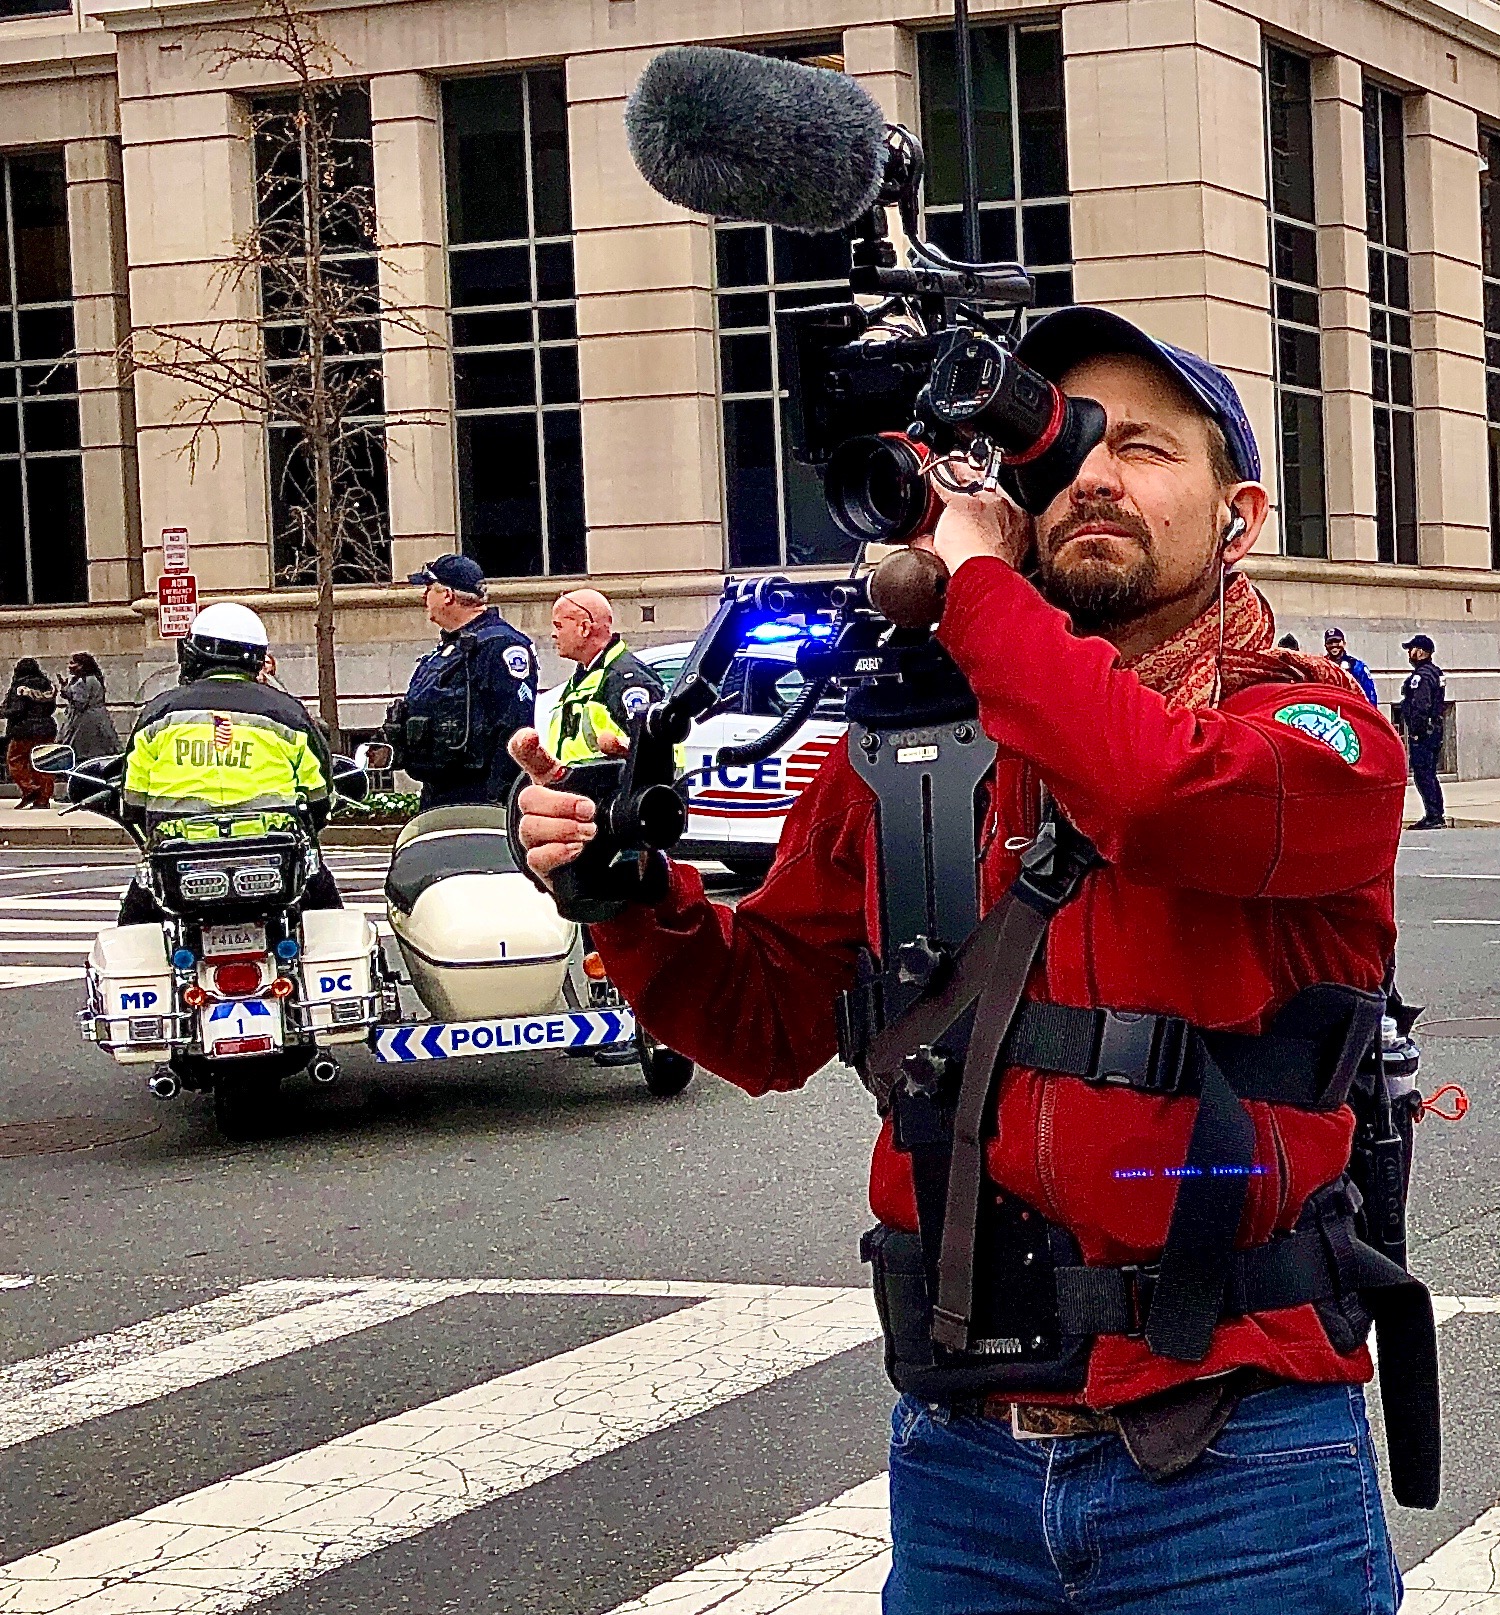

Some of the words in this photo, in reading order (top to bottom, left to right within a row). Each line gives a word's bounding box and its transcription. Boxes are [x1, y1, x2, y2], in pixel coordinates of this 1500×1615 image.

[854, 657, 880, 672] ARRI
[687, 754, 782, 790] ICE
[499, 941, 507, 957] 1
[319, 974, 353, 993] DC
[120, 991, 158, 1010] MP
[236, 1018, 244, 1035] 1
[450, 1021, 565, 1050] POLICE
